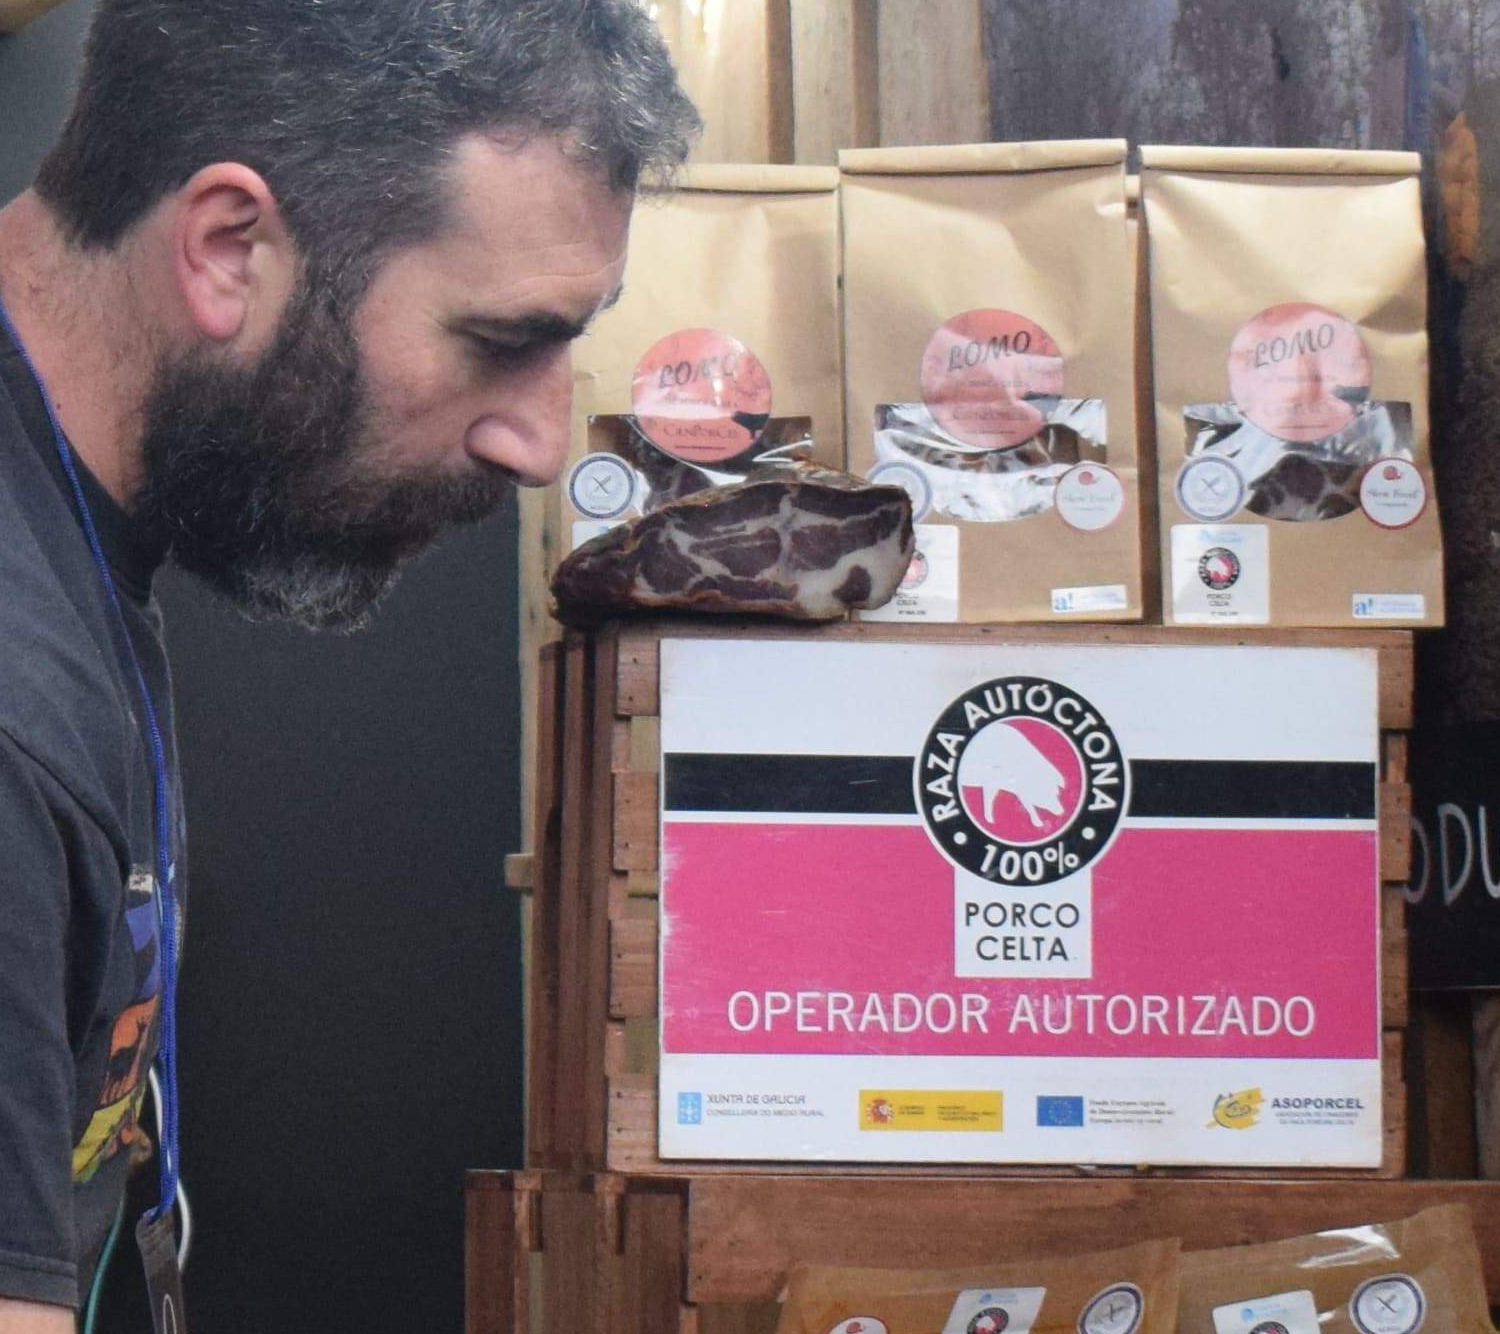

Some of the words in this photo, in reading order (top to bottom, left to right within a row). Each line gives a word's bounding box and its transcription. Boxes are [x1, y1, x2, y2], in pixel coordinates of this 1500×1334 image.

[947, 330, 1030, 372] LOMO
[1253, 323, 1335, 367] LOMO
[962, 683, 1120, 812] AUTÓCTONA
[926, 730, 966, 823] RAZA
[979, 841, 1080, 882] 100%
[965, 902, 1080, 928] PORCO
[975, 936, 1069, 961] CELTA
[727, 990, 990, 1035] OPERADOR
[1007, 993, 1317, 1038] AUTORIZADO
[706, 1093, 744, 1105] XUNTA
[746, 1094, 760, 1105] DE
[761, 1094, 806, 1106] GALICIA
[1270, 1096, 1366, 1111] ASOPORCEL
